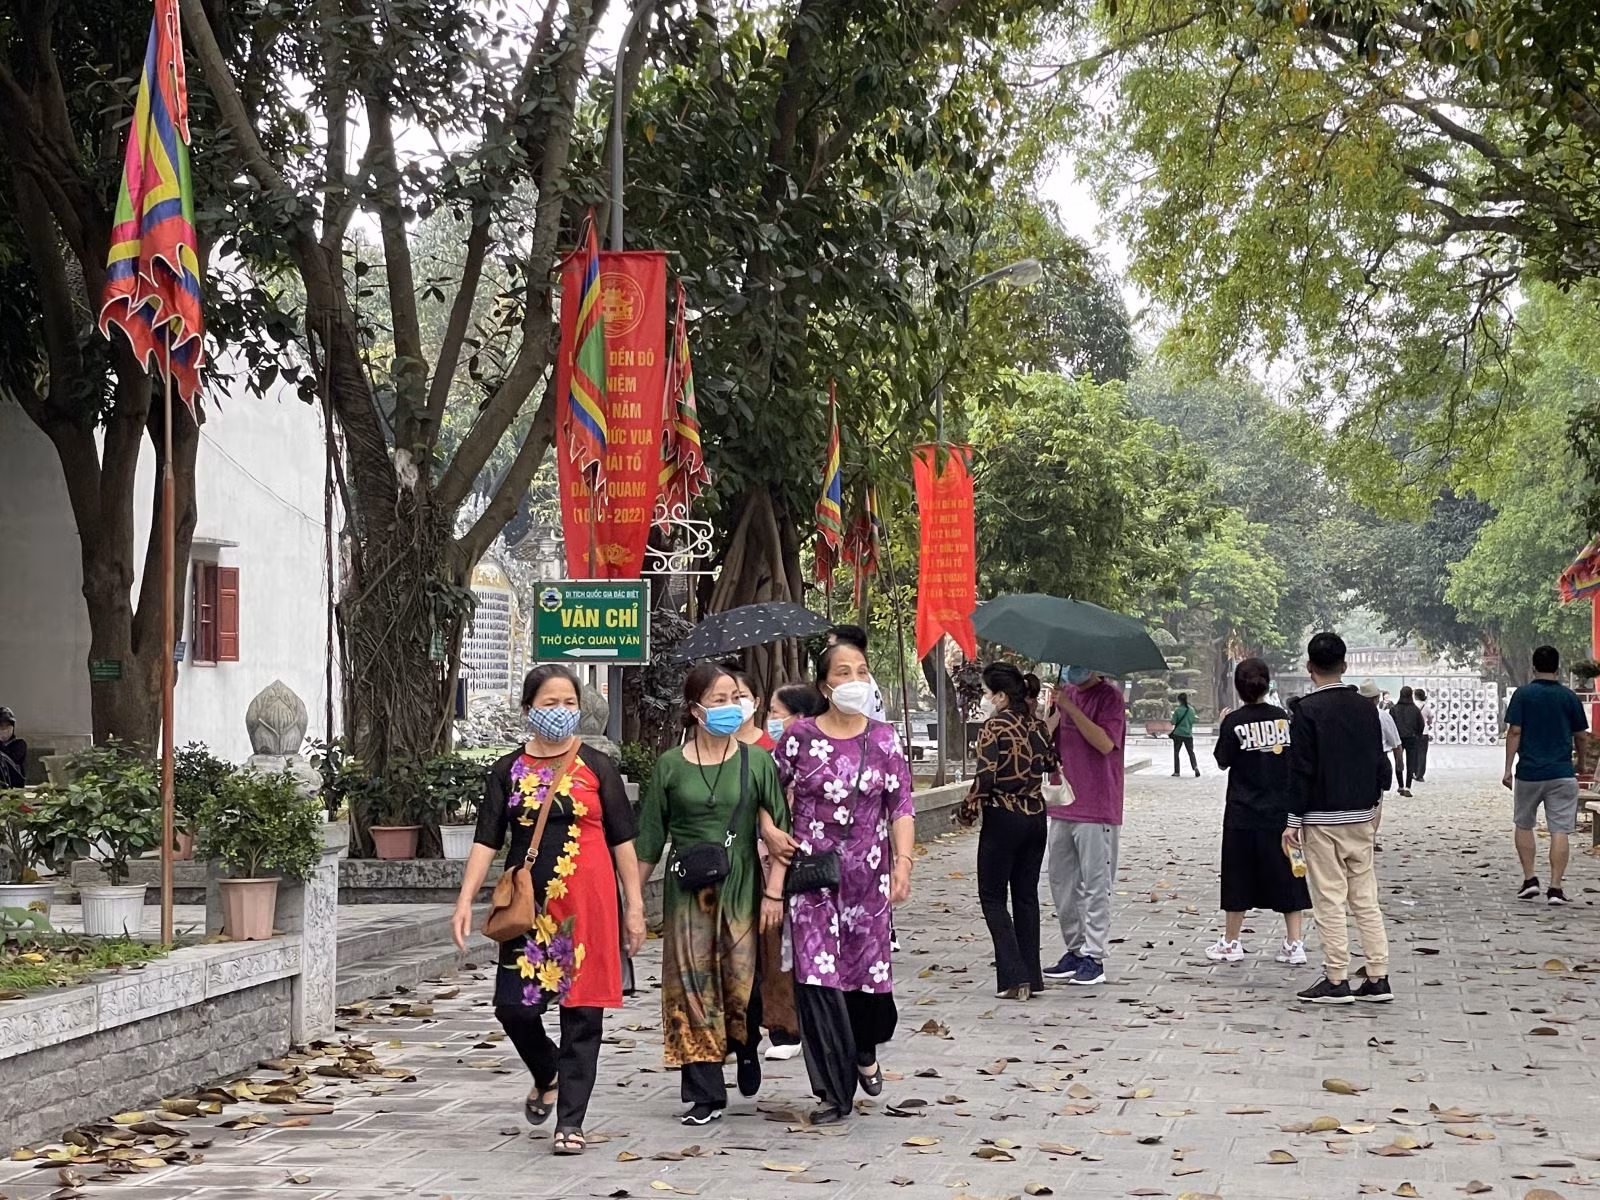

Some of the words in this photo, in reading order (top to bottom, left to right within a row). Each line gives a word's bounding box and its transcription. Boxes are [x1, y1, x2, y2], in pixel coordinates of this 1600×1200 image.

[613, 400, 641, 418] NĂM
[631, 429, 653, 444] VUA
[561, 604, 599, 627] VĂN
[605, 602, 638, 627] CHỈ
[564, 634, 585, 645] CÁC
[588, 636, 616, 645] QUAN
[619, 634, 640, 645] VĂN
